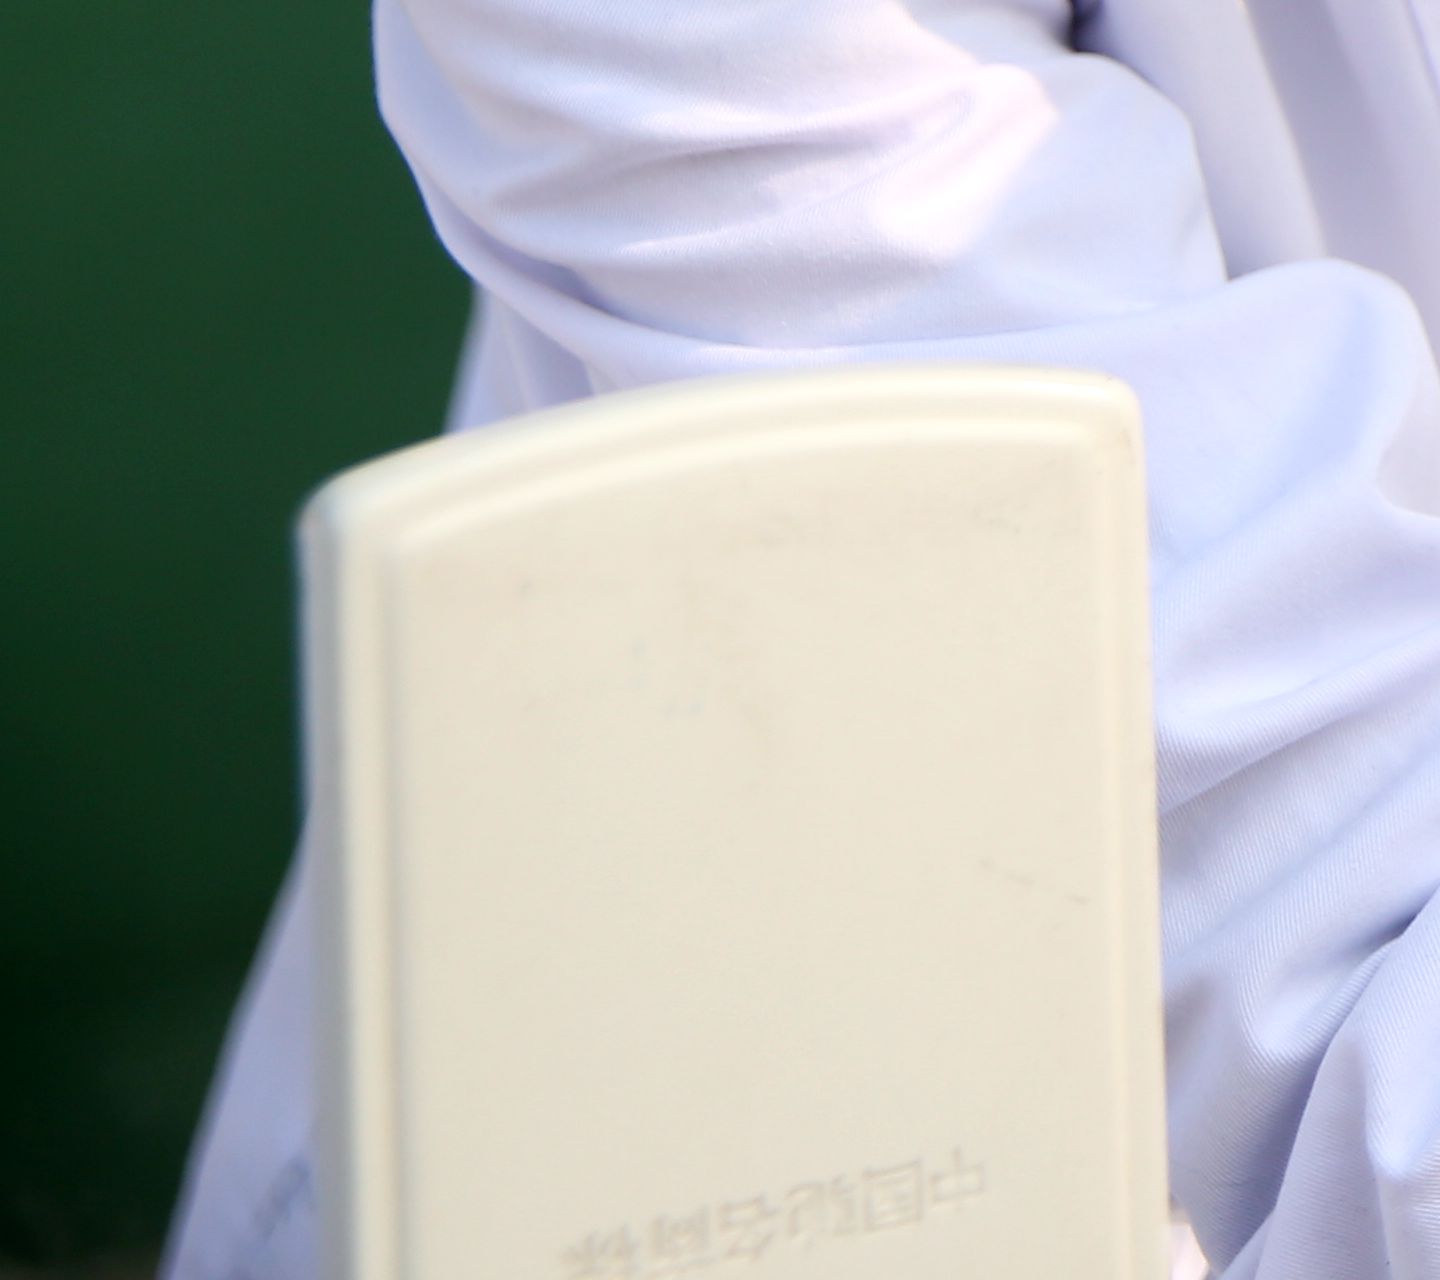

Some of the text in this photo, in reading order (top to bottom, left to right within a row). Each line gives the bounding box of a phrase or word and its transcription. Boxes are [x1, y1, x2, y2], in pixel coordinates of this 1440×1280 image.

[558, 1144, 988, 1280] 中国驰名商标
